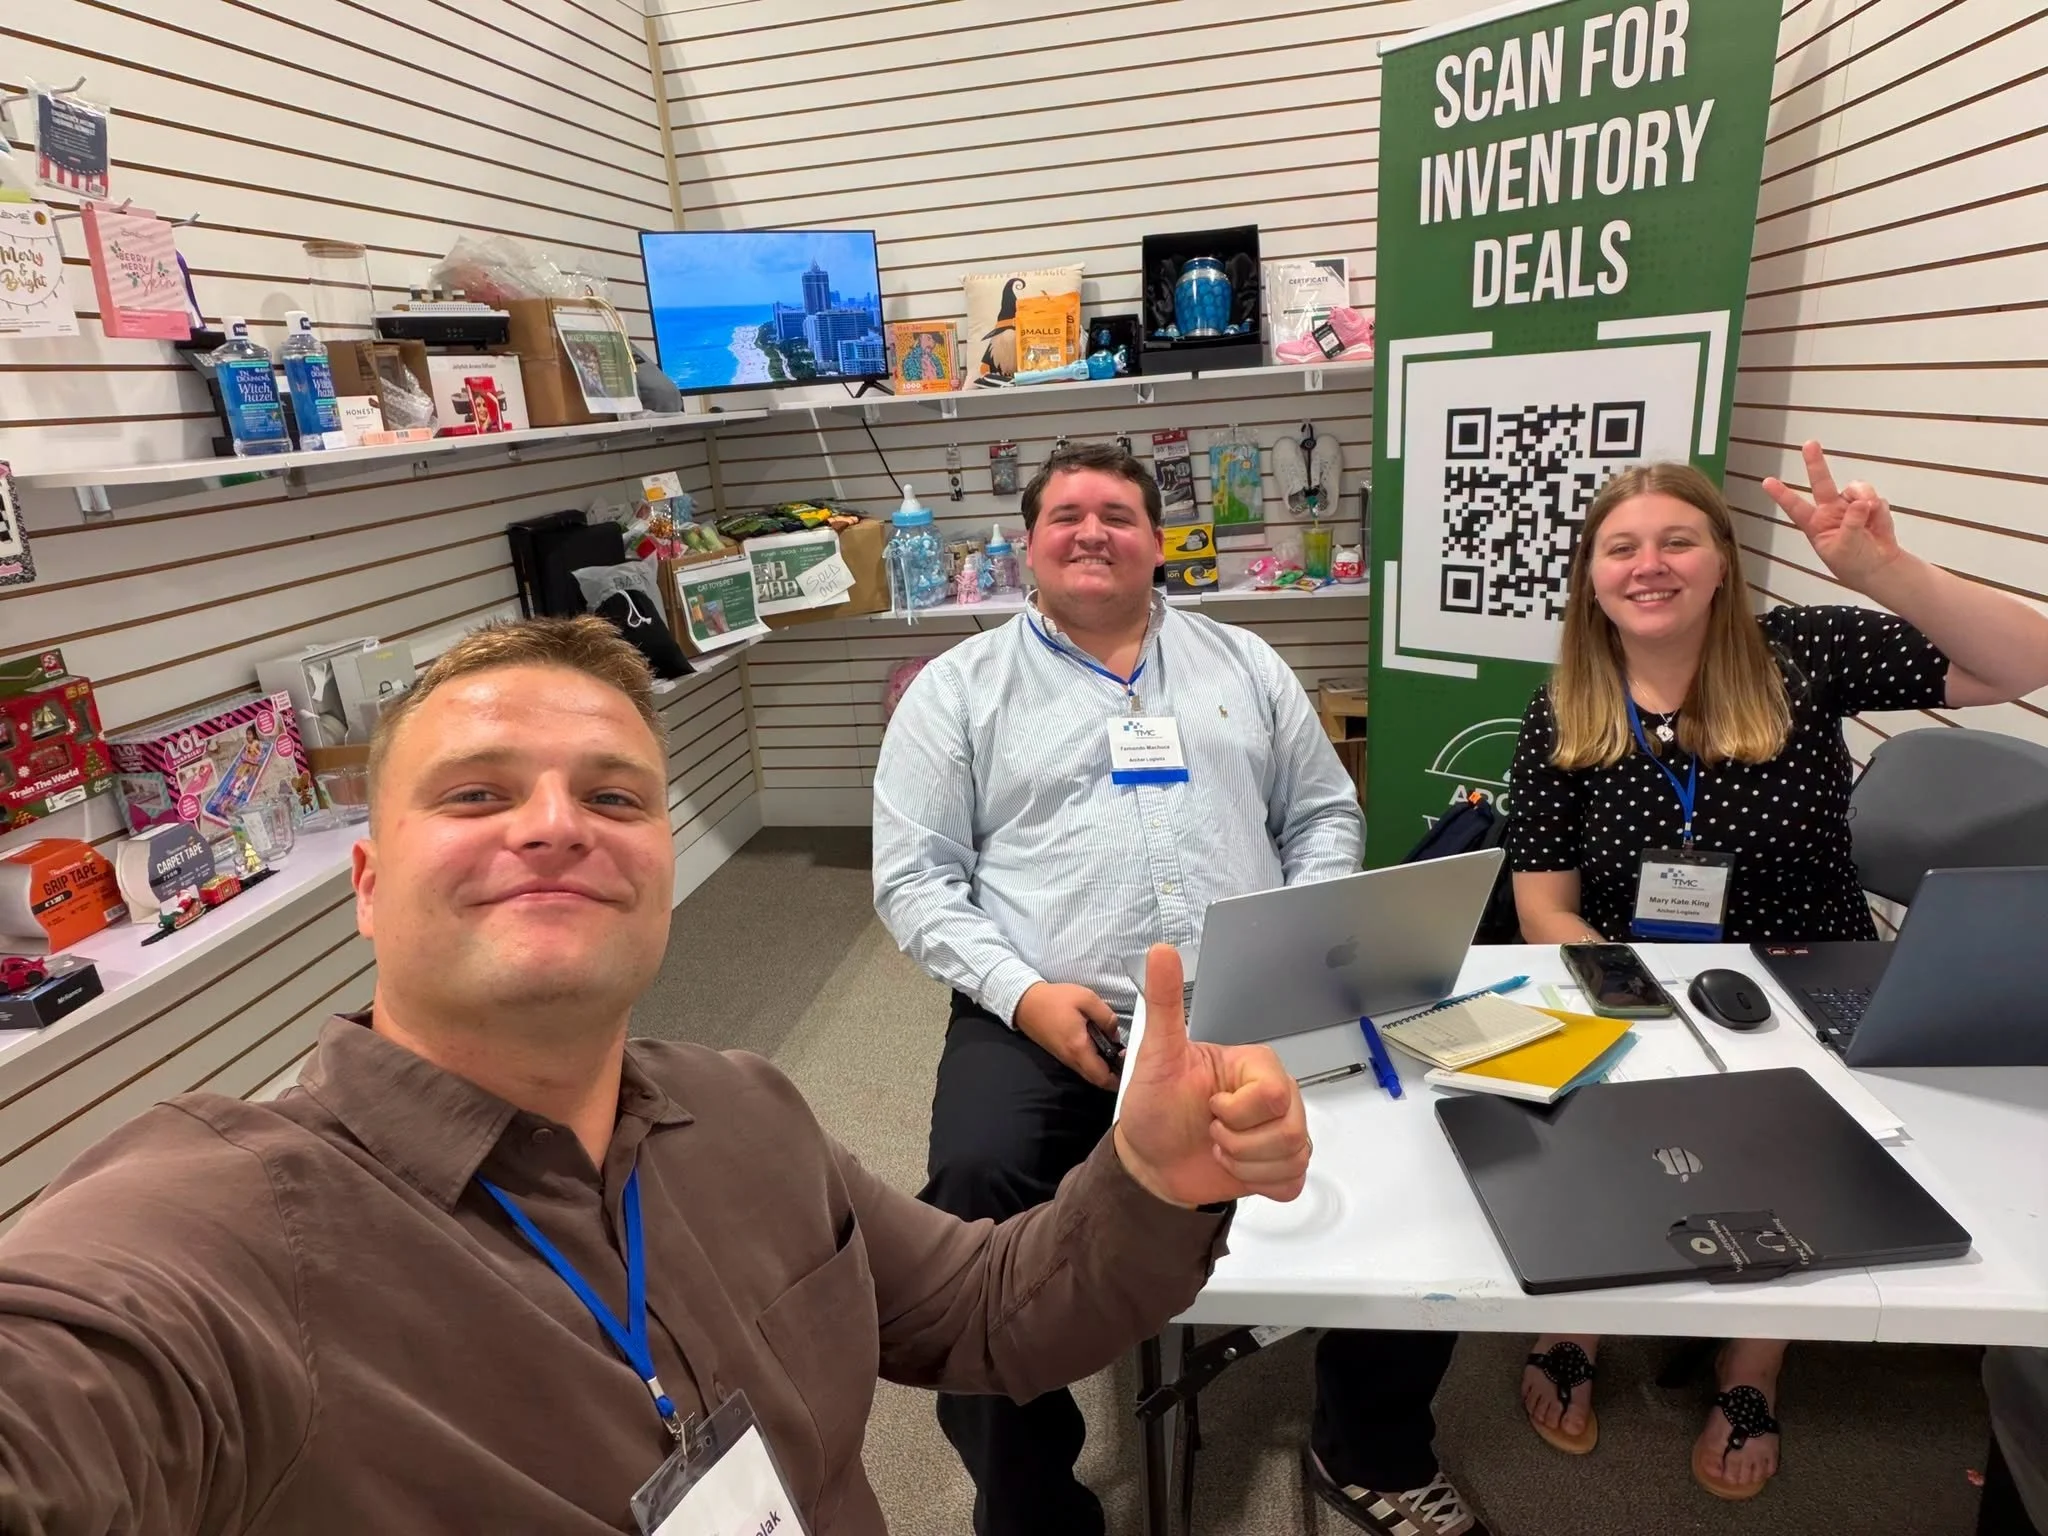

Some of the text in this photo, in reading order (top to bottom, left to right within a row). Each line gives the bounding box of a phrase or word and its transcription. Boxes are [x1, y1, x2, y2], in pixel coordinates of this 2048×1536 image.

[1434, 0, 1690, 129] SCAN FOR
[1420, 98, 1716, 226] INVENTORY
[119, 252, 148, 262] BERRY
[1472, 219, 1632, 309] DEALS
[120, 262, 150, 272] MERRY
[1288, 276, 1329, 286] CERTIFICATE
[1020, 327, 1061, 337] SMALLS
[238, 381, 271, 394] Witch
[243, 390, 274, 403] hazel
[346, 407, 375, 416] HONEST
[806, 563, 841, 592] SOLD
[819, 578, 839, 598] OUT
[1134, 729, 1157, 737] TMC
[9, 767, 80, 800] Train The World
[156, 842, 205, 875] CARPET TAPE
[43, 874, 69, 897] GRIP
[68, 862, 98, 883] TAPE
[1671, 878, 1699, 888] TMC
[1648, 896, 1710, 908] Mary Kate King
[1707, 1218, 1736, 1254] streaming
[1772, 1218, 1810, 1266] Free listening
